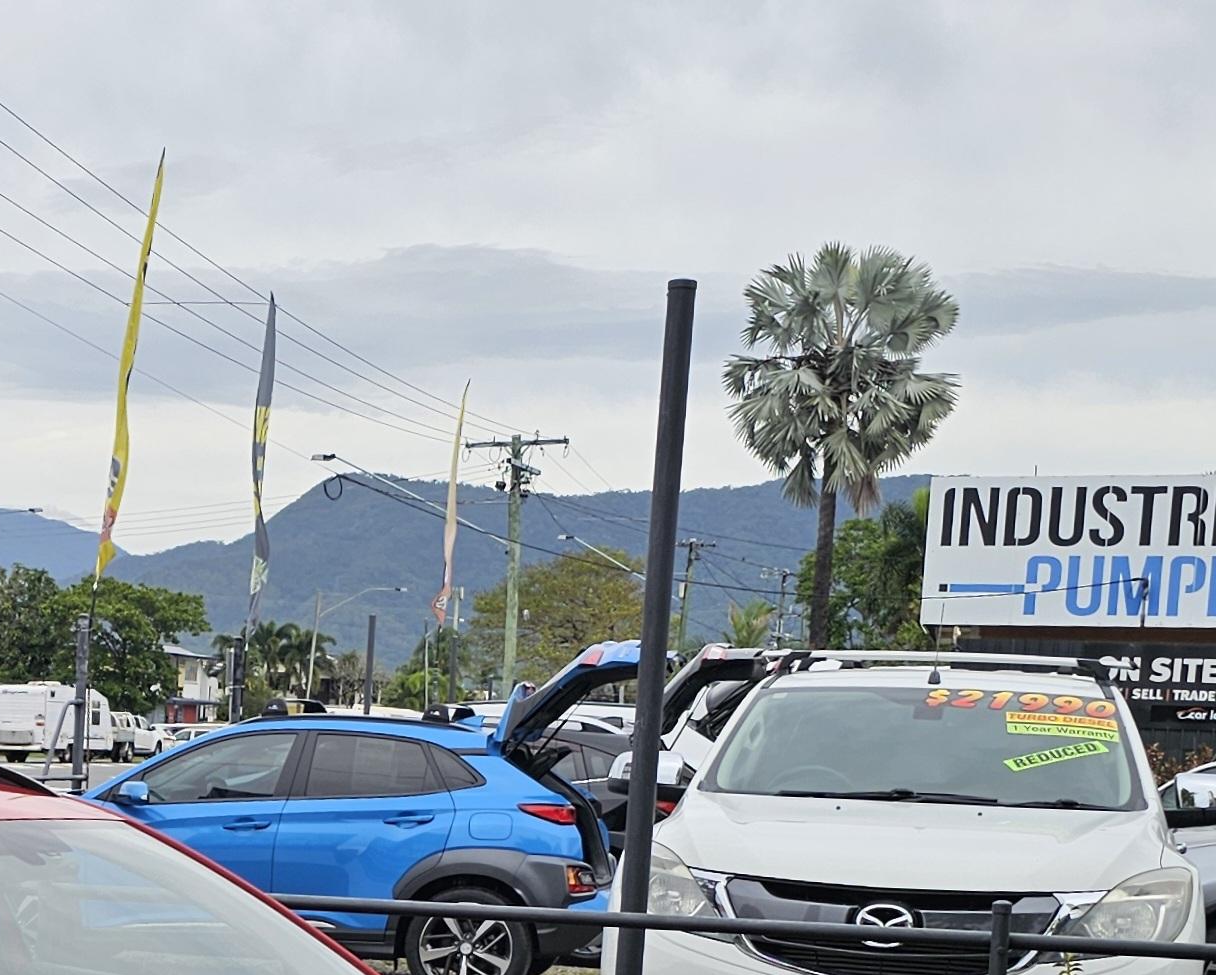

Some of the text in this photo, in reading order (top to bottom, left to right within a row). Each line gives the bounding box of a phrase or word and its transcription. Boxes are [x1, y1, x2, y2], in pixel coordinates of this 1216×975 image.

[940, 485, 1216, 547] INDUSTR
[1148, 656, 1216, 684] SITE
[925, 688, 1117, 718] $21990
[1131, 688, 1164, 701] SELL
[1172, 689, 1216, 702] TRADE
[1008, 712, 1115, 729] TURBO DIESEL
[1023, 725, 1053, 733] Year
[1056, 726, 1116, 740] Warranty
[1012, 742, 1099, 768] REDUCED
